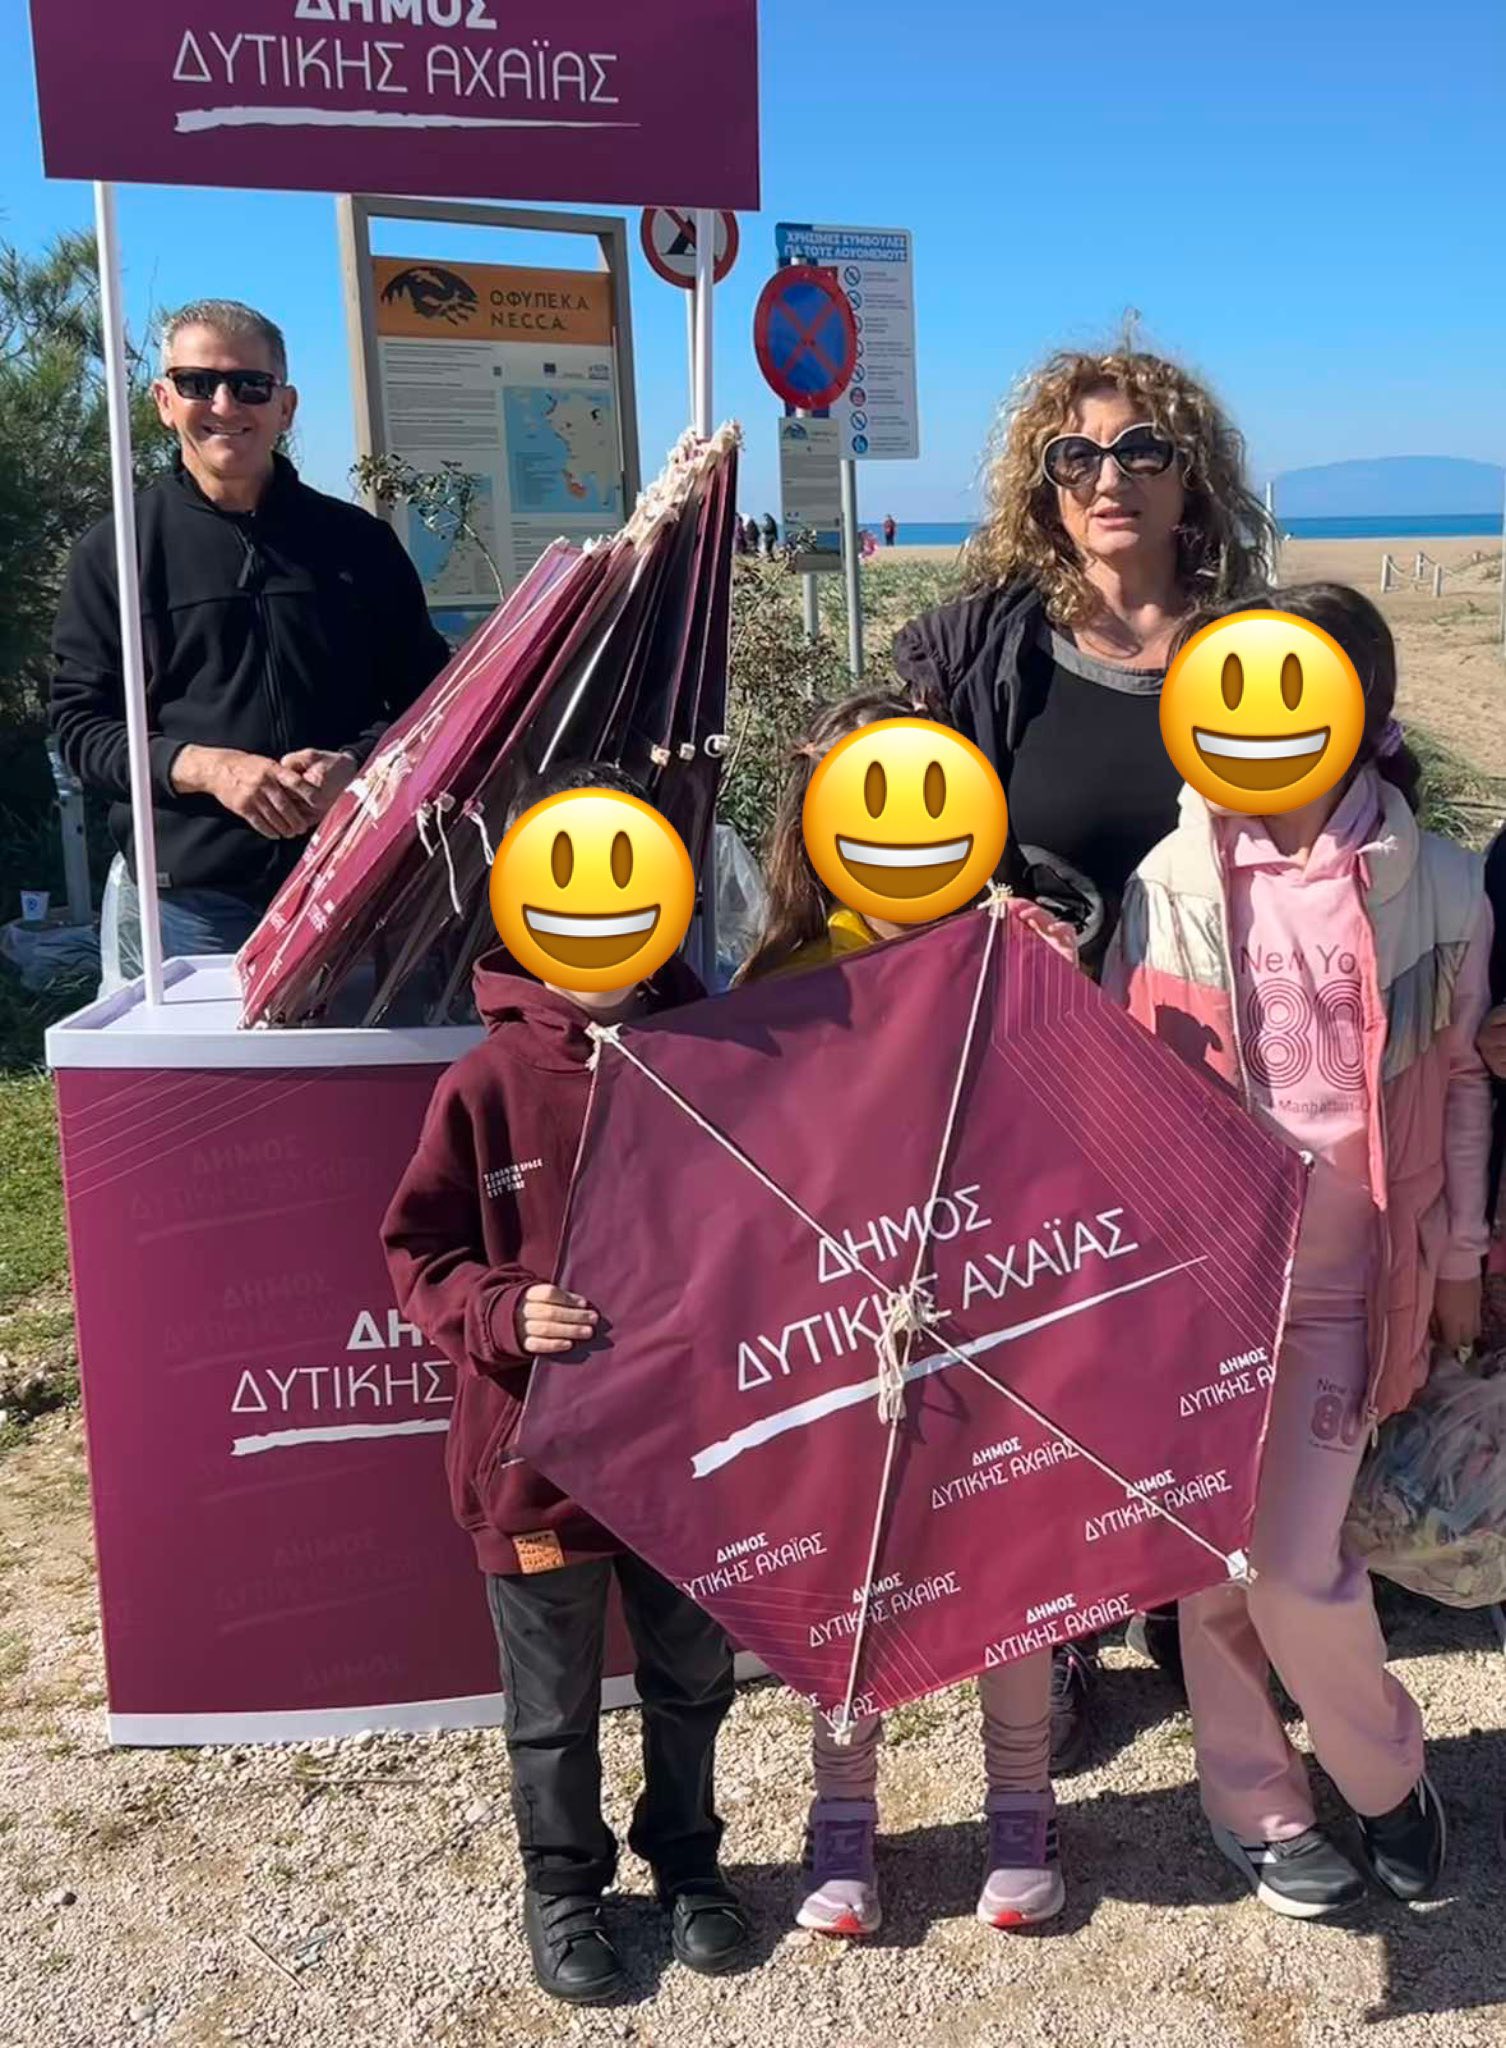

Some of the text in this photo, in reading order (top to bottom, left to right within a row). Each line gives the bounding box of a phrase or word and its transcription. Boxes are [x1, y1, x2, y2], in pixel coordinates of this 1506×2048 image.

[173, 30, 620, 103] ΔΥΤΙΚΗΣ ΑΧΑΪΑΣ
[1242, 977, 1368, 1091] 80
[818, 1184, 992, 1284] ΔΗΜΟΣ
[961, 1207, 1139, 1310] ΑΧΑΪΑΣ
[1219, 1347, 1268, 1375] ΔΗΜΟΣ
[230, 1360, 455, 1413] ΔΥΤΙΚΗΣ
[1180, 1372, 1255, 1417] ΔΥΤΙΚΗΣ
[972, 1437, 1021, 1466] ΔΗΜΟΣ
[931, 1440, 1079, 1509] ΔΥΤΙΚΗΣ ΑΧΑΪΑΣ
[1126, 1469, 1175, 1499] ΔΗΜΟΣ
[1164, 1470, 1232, 1511] ΑΧΑΪΑΣ
[717, 1533, 769, 1563] ΔΗΜΟΣ
[755, 1532, 827, 1575] ΑΧΑΪΑΣ
[891, 1571, 961, 1615] ΑΧΑΪΑΣ
[1026, 1593, 1077, 1624] ΔΗΜΟΣ
[984, 1594, 1136, 1668] ΔΥΤΙΚΗΣ ΑΧΑΪΑΣ
